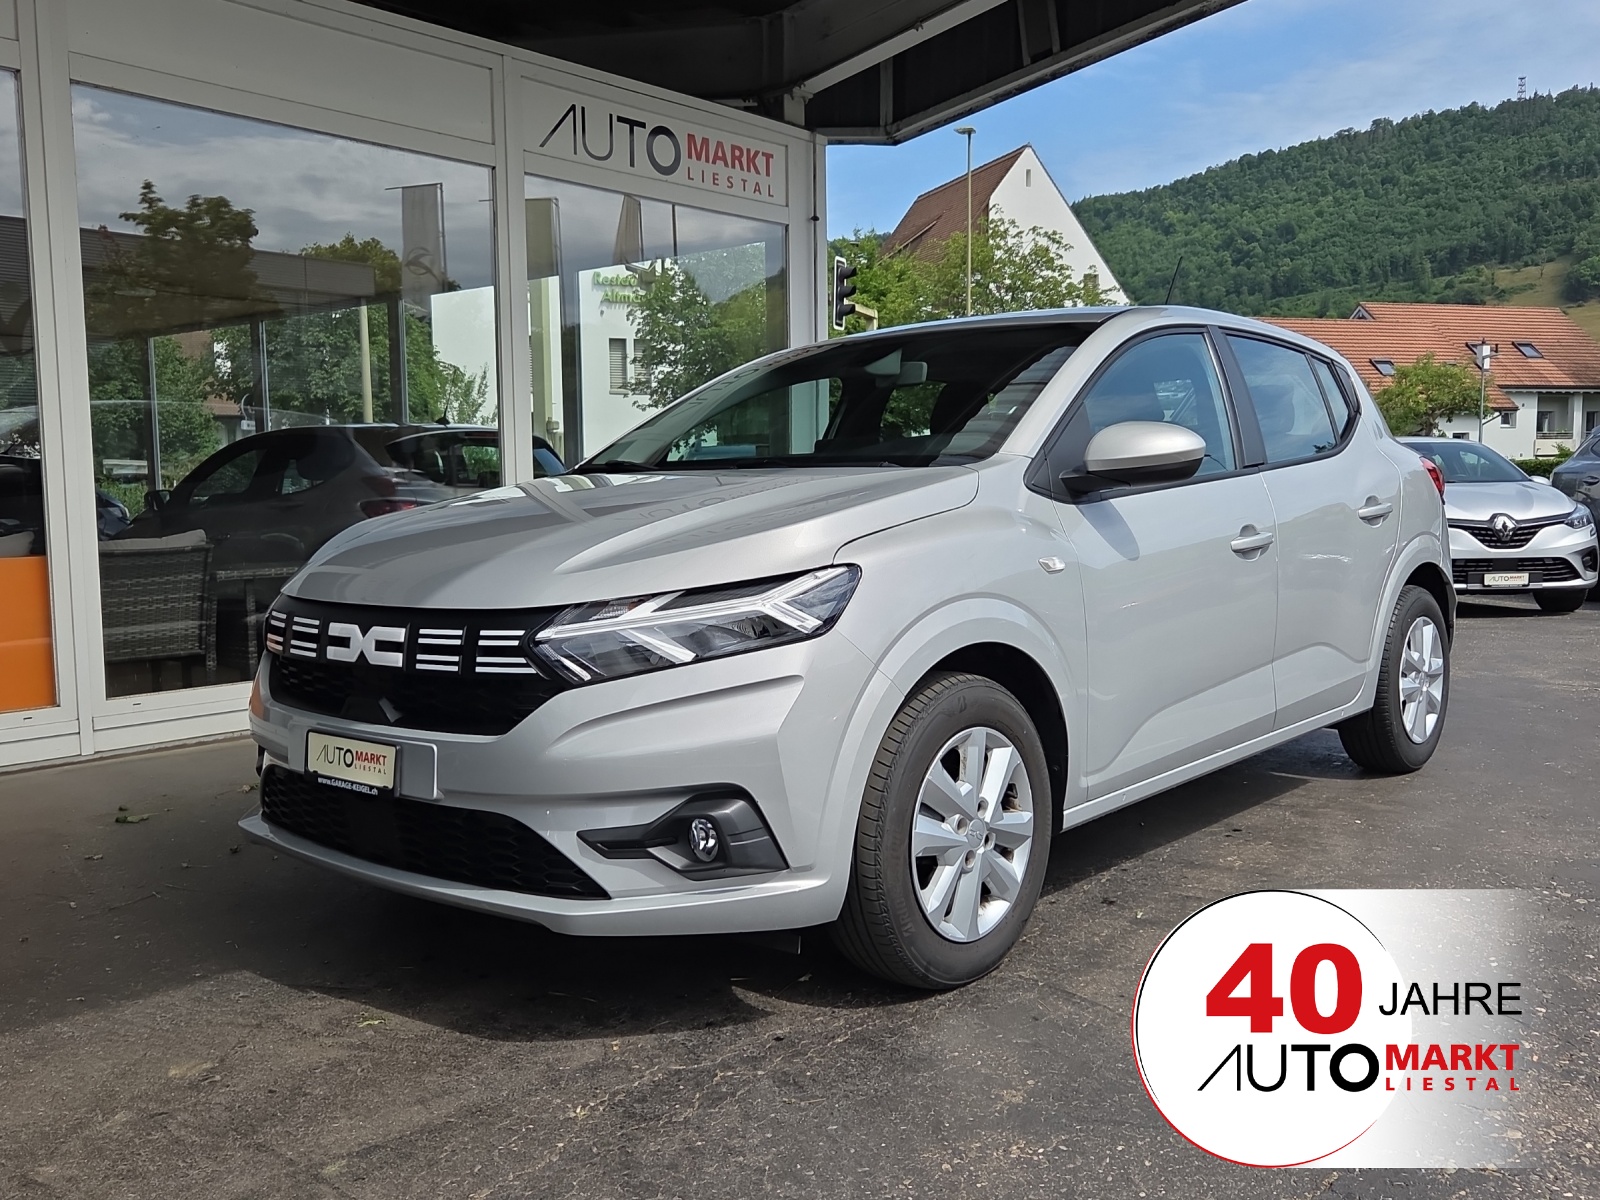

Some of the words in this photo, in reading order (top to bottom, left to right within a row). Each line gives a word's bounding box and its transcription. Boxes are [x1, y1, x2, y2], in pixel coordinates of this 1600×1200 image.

[539, 103, 682, 176] AUTO
[687, 133, 774, 177] MARKT
[687, 166, 774, 198] LIESTAL
[316, 744, 354, 768] AUTO
[355, 750, 387, 767] MARKT
[354, 763, 387, 775] LIESTAL
